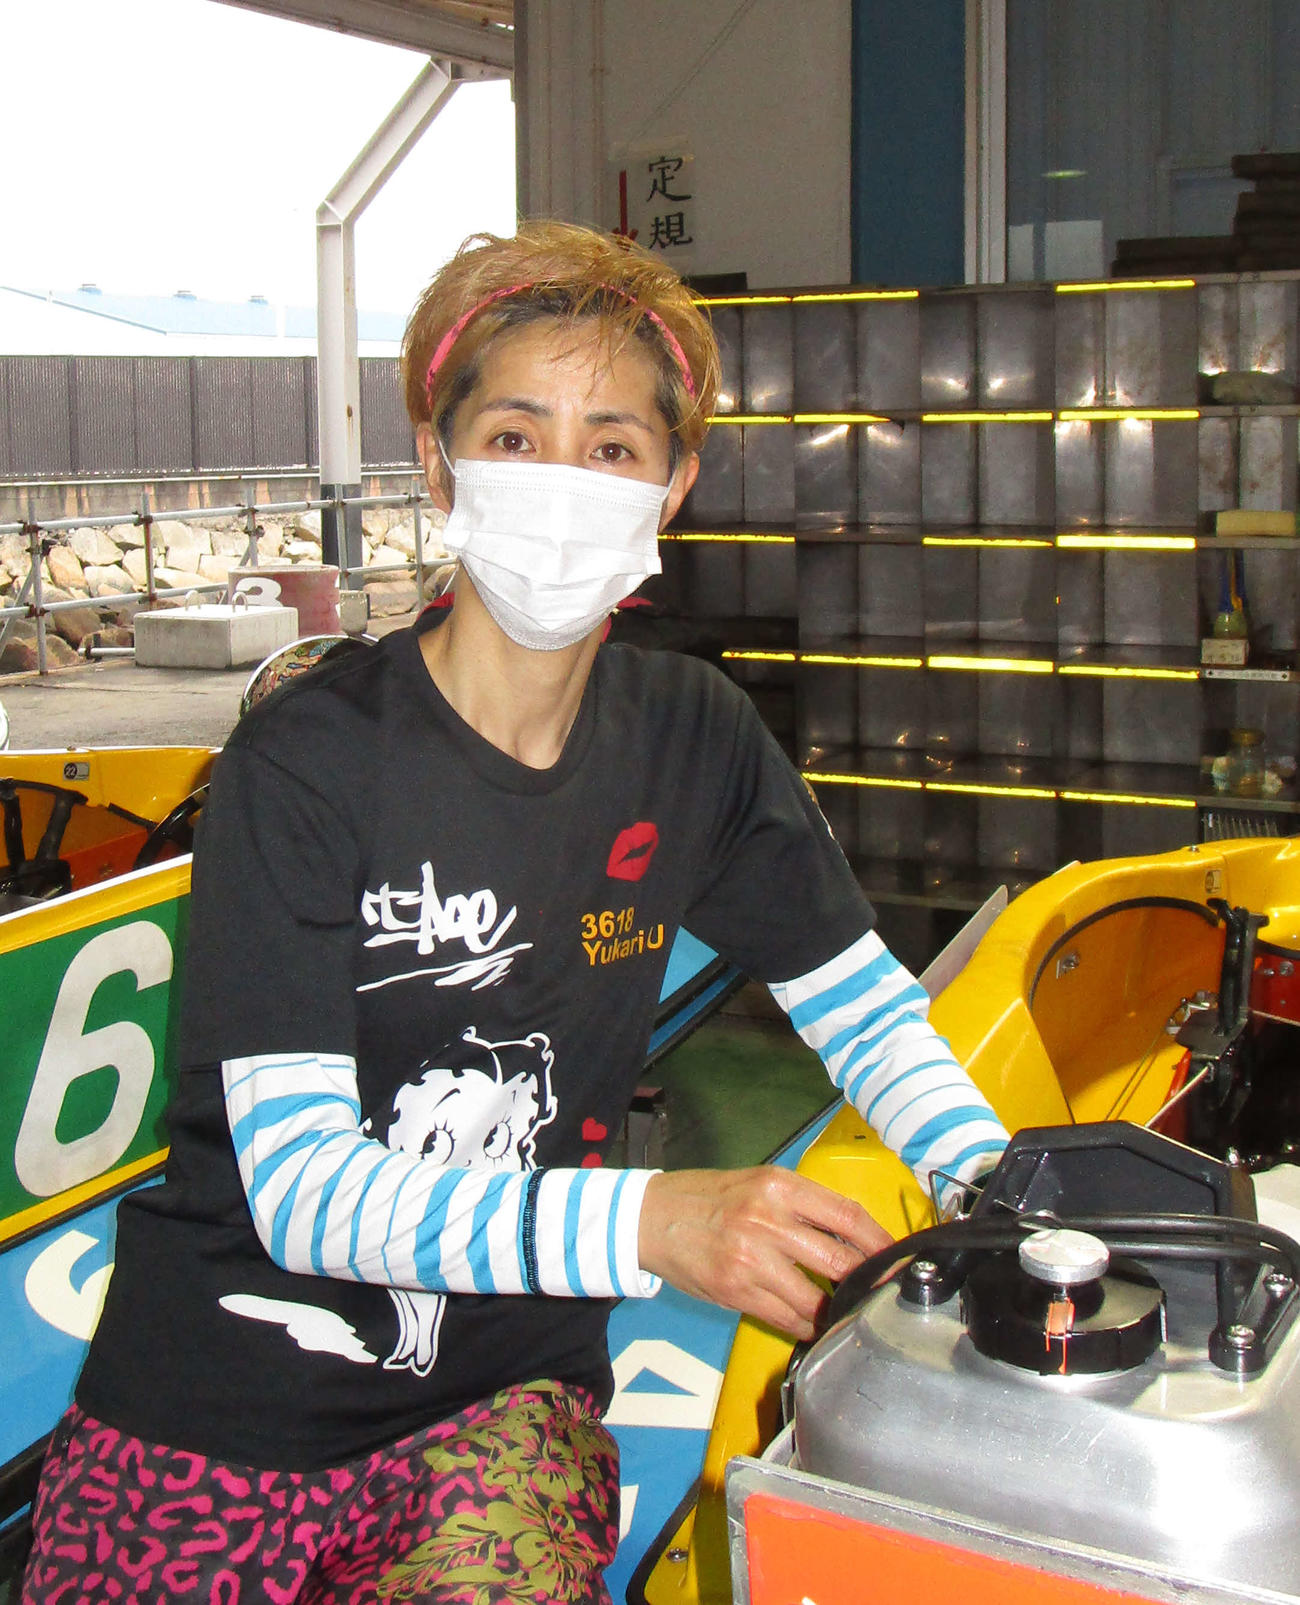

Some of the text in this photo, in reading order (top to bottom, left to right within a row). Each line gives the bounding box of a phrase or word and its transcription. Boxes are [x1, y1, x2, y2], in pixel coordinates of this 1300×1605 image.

[646, 155, 694, 250] 定規
[580, 906, 635, 940] 3618
[14, 920, 174, 1198] 6
